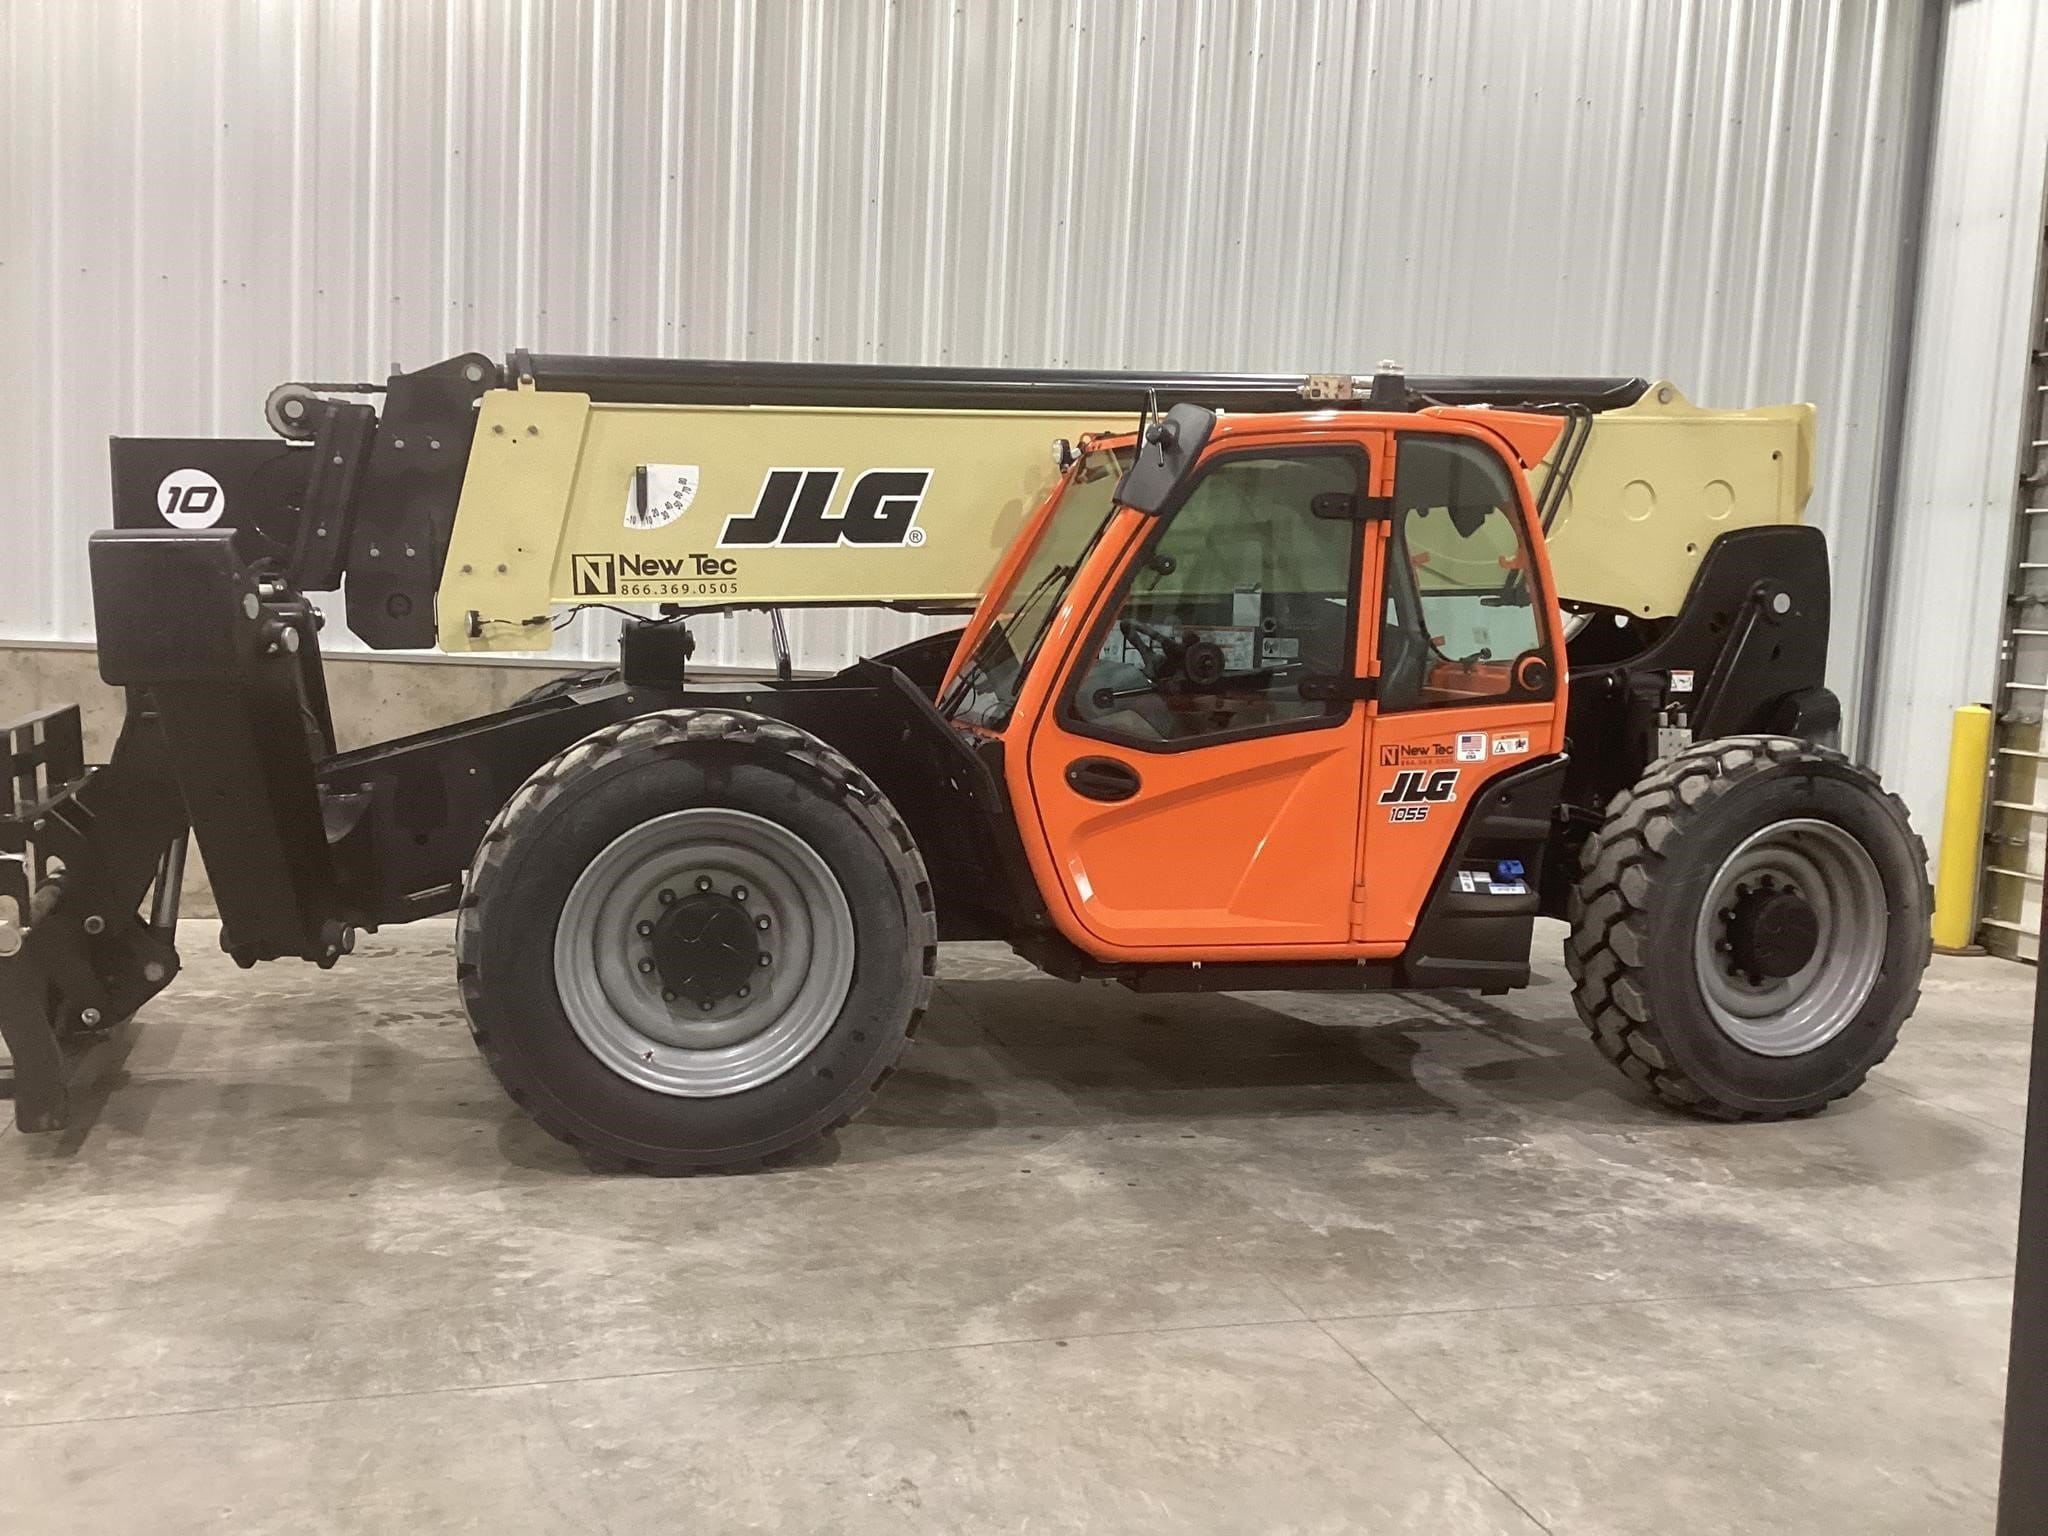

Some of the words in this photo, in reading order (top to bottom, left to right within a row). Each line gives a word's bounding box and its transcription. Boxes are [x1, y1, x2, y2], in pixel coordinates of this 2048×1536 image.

[165, 486, 218, 514] 10
[721, 471, 930, 545] JLG
[651, 507, 660, 518] 20
[619, 554, 684, 576] New
[689, 553, 738, 576] Tec
[621, 583, 738, 595] 866.369.0505
[1401, 745, 1430, 756] New
[1432, 743, 1454, 755] Tec
[1381, 771, 1458, 803] JLG
[1391, 807, 1429, 821] 1055
